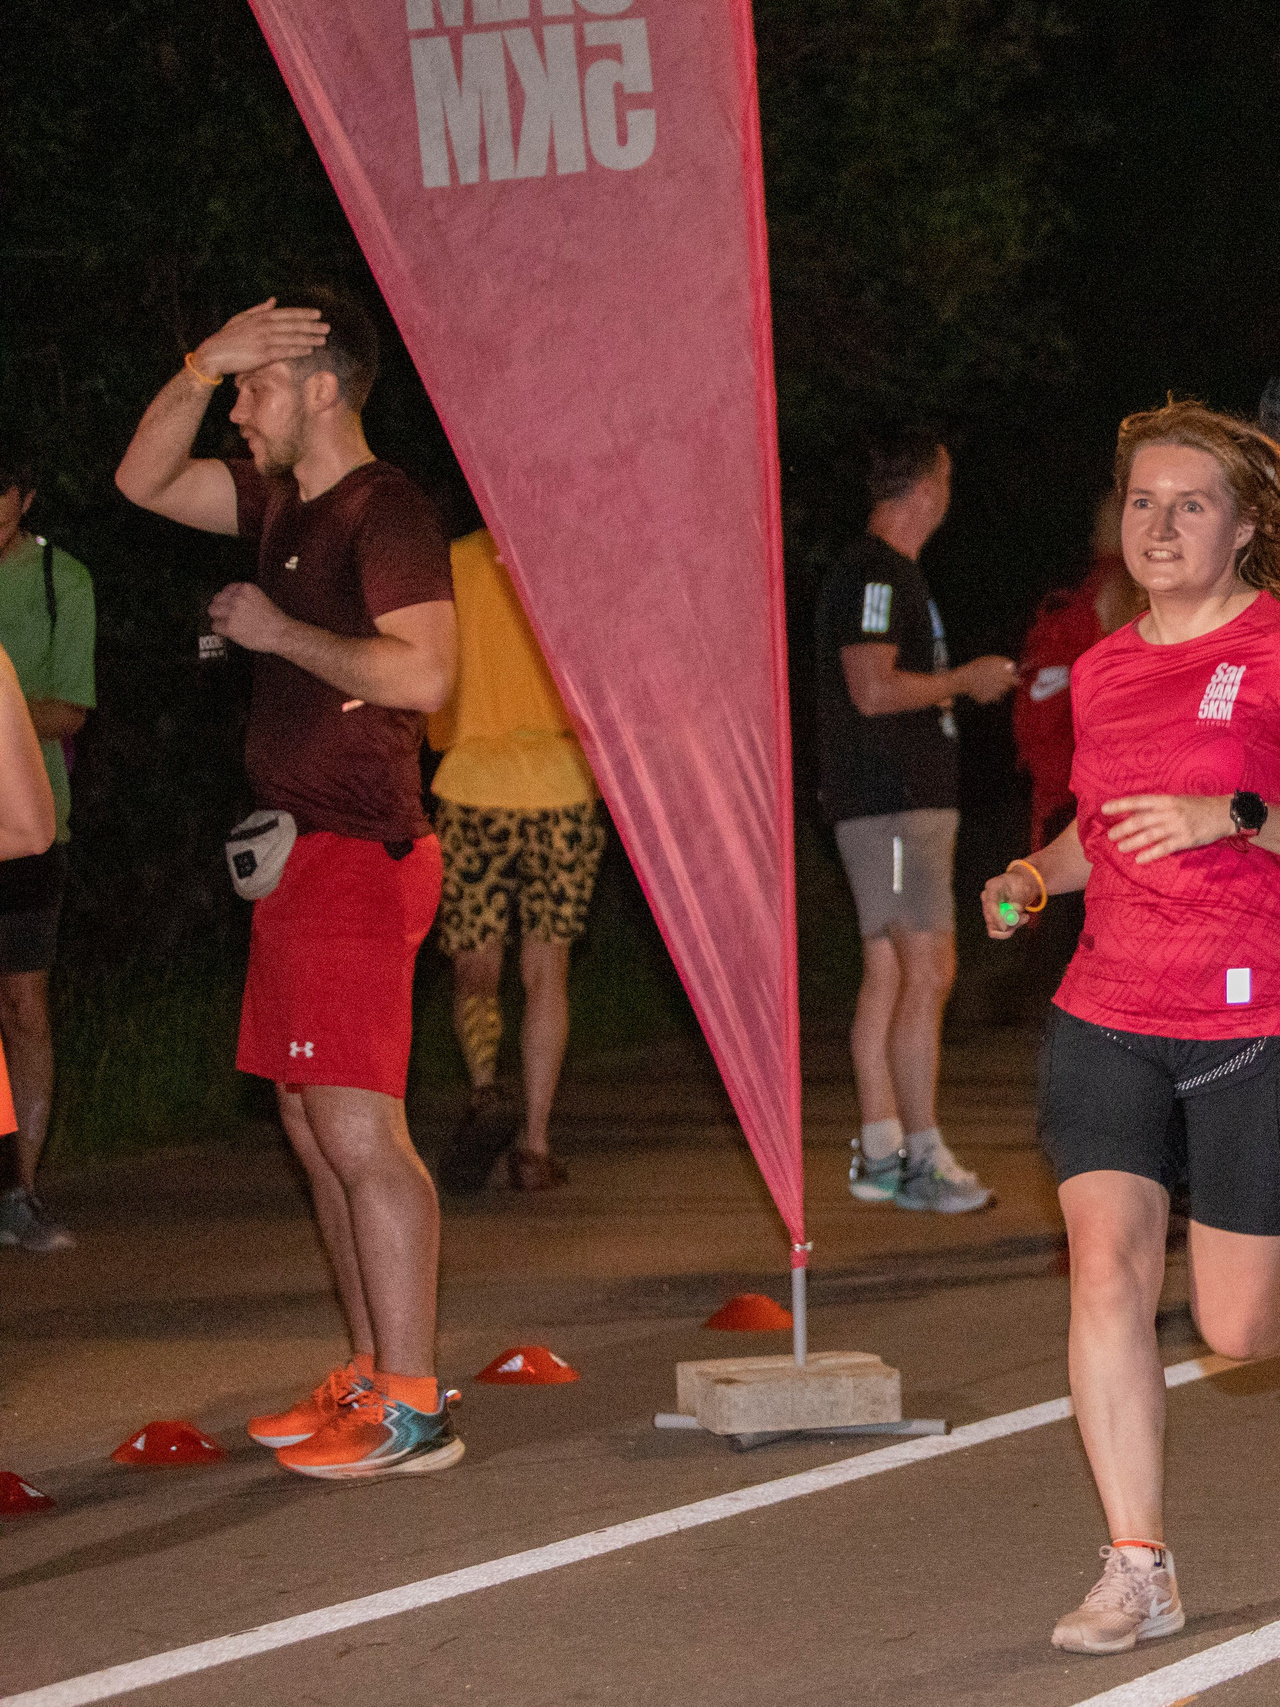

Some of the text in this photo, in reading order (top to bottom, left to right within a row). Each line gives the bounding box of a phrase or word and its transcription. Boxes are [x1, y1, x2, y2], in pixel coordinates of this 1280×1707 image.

[1211, 662, 1247, 684] Sat
[1204, 682, 1240, 702] 9AM
[1198, 700, 1234, 720] 5KM
